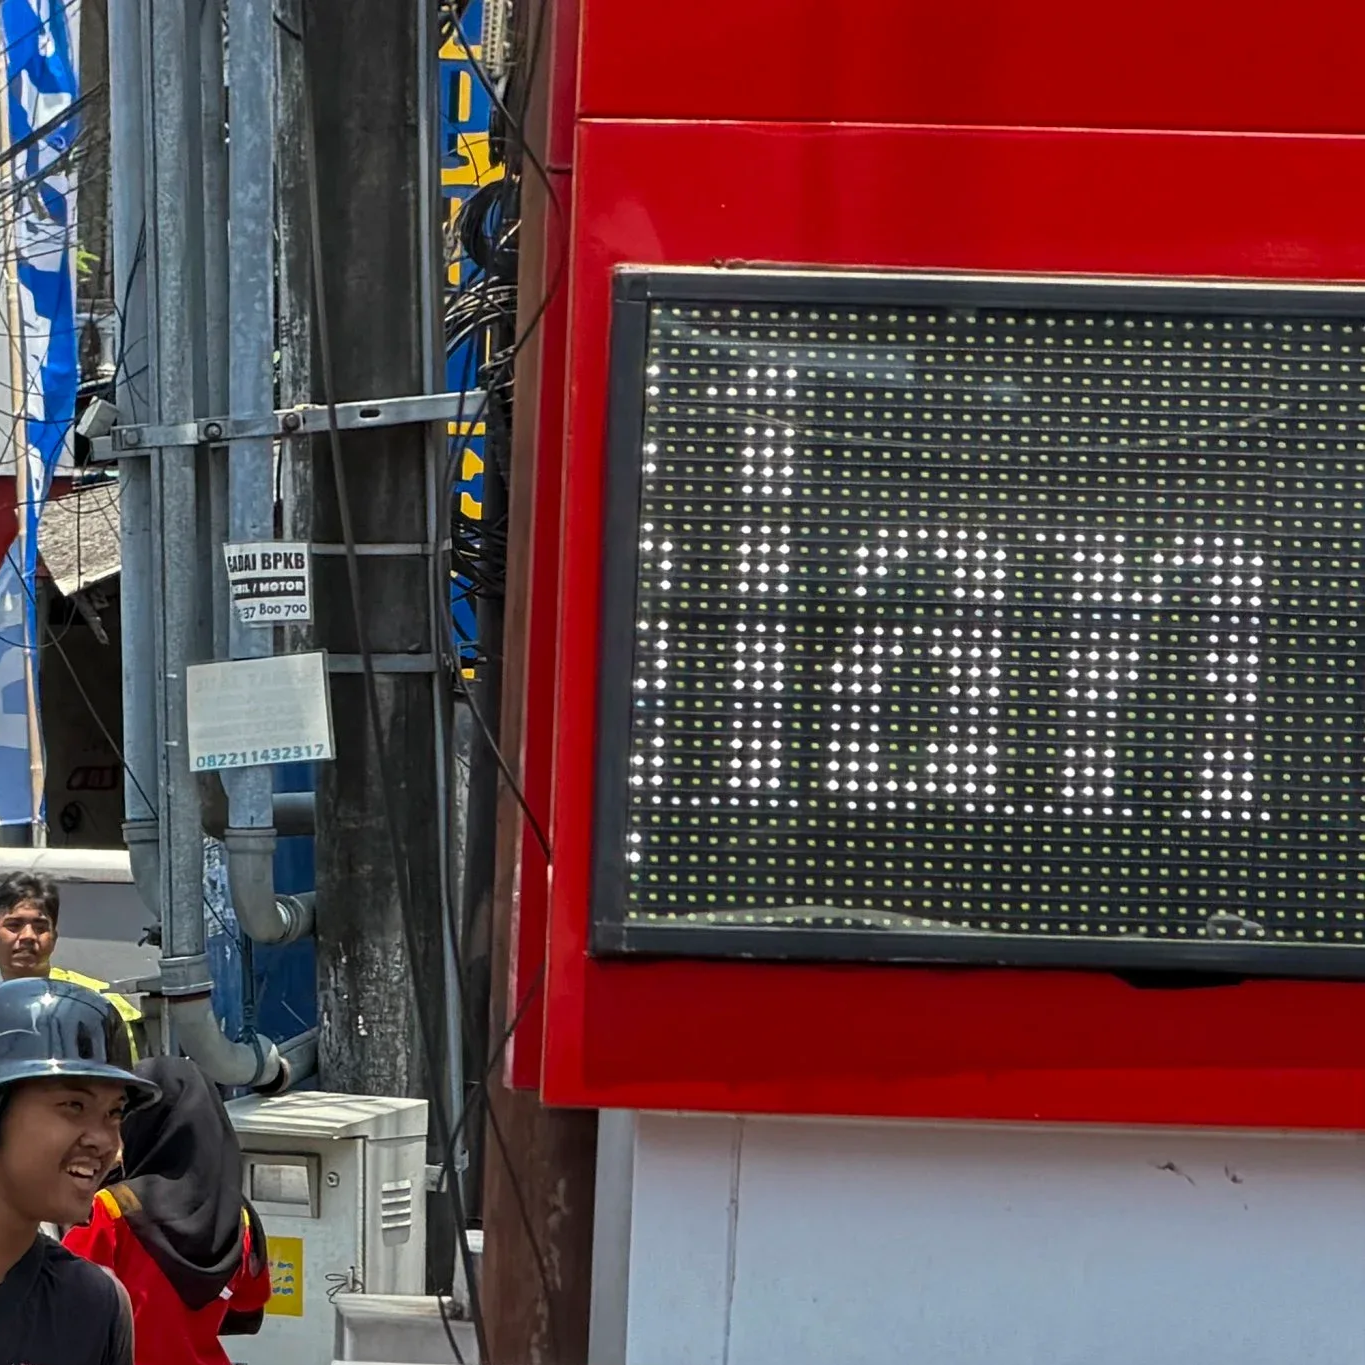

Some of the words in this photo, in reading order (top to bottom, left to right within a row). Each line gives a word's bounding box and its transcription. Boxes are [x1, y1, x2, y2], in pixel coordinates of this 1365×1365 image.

[261, 552, 305, 570] BPKB
[259, 581, 304, 593] MOTOR
[284, 604, 308, 617] 700
